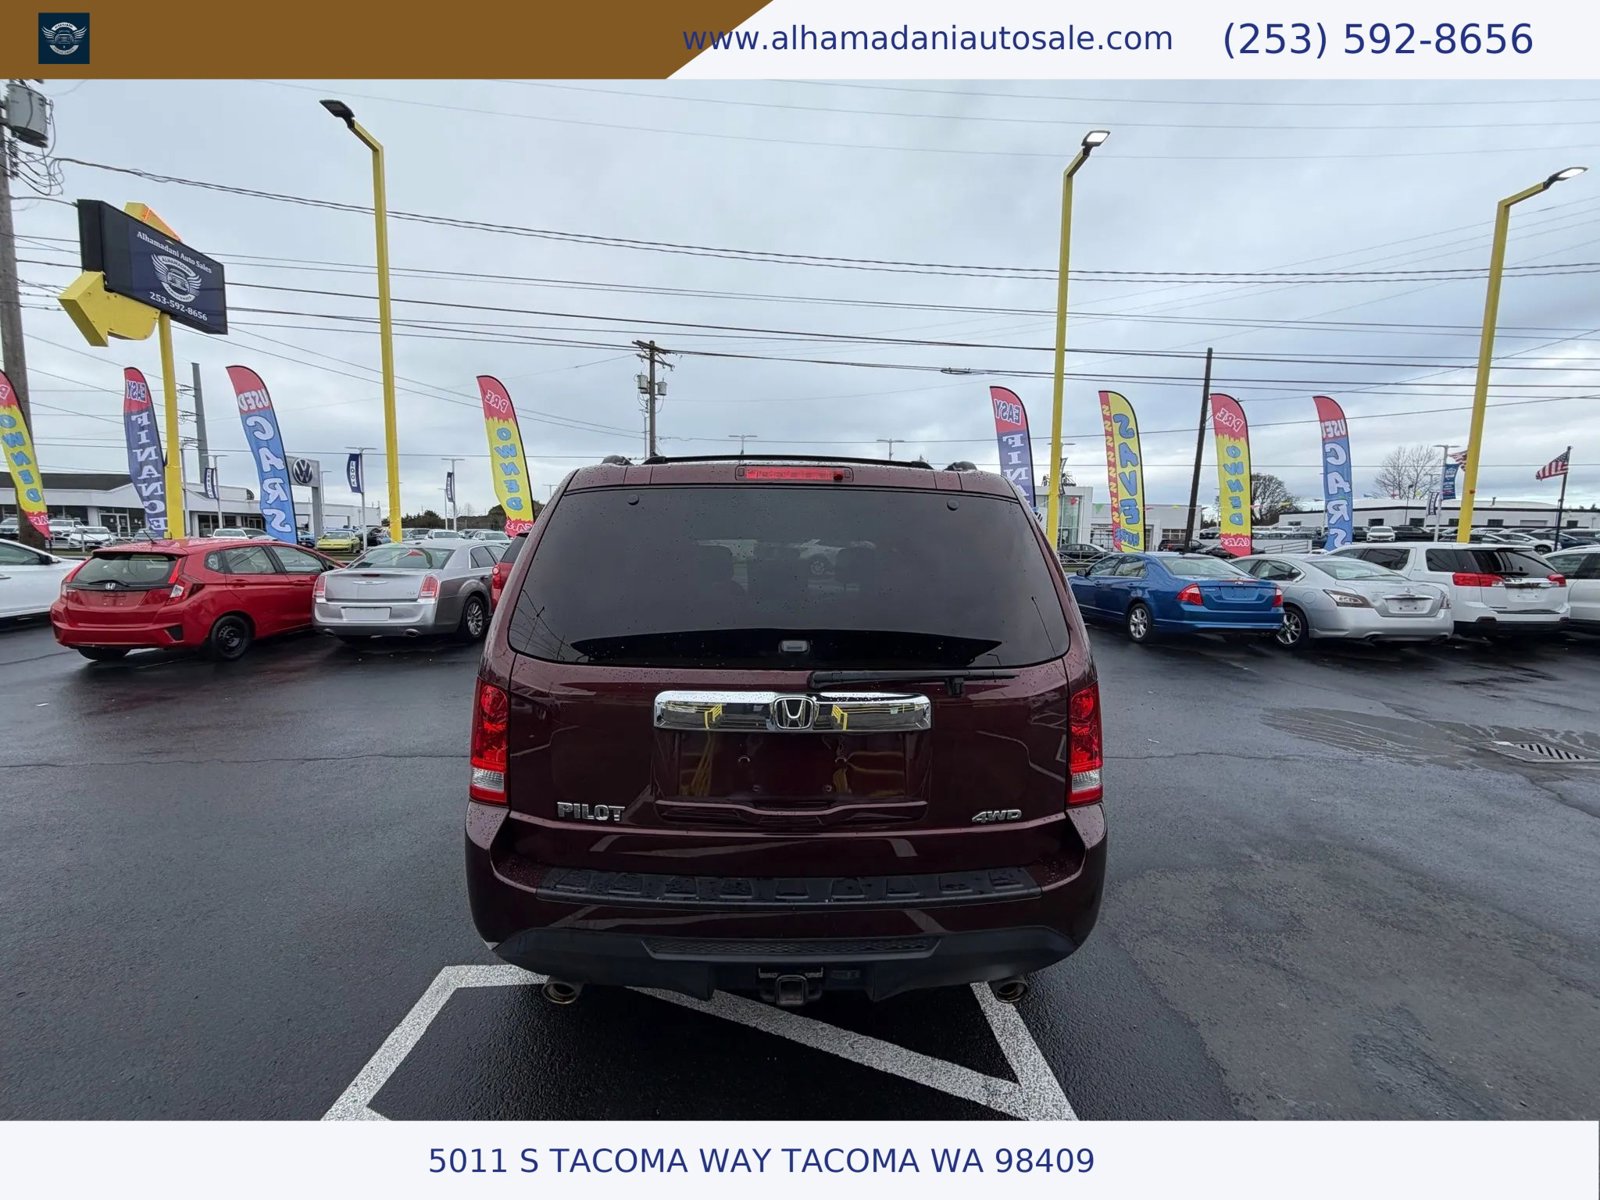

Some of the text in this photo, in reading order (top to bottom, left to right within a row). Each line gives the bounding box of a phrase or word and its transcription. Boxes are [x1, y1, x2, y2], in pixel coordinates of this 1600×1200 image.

[136, 231, 213, 275] Alhamadani Auto Sales
[149, 291, 208, 321] 253-592-8656
[557, 801, 626, 822] PILOT
[971, 808, 1022, 823] 4WD
